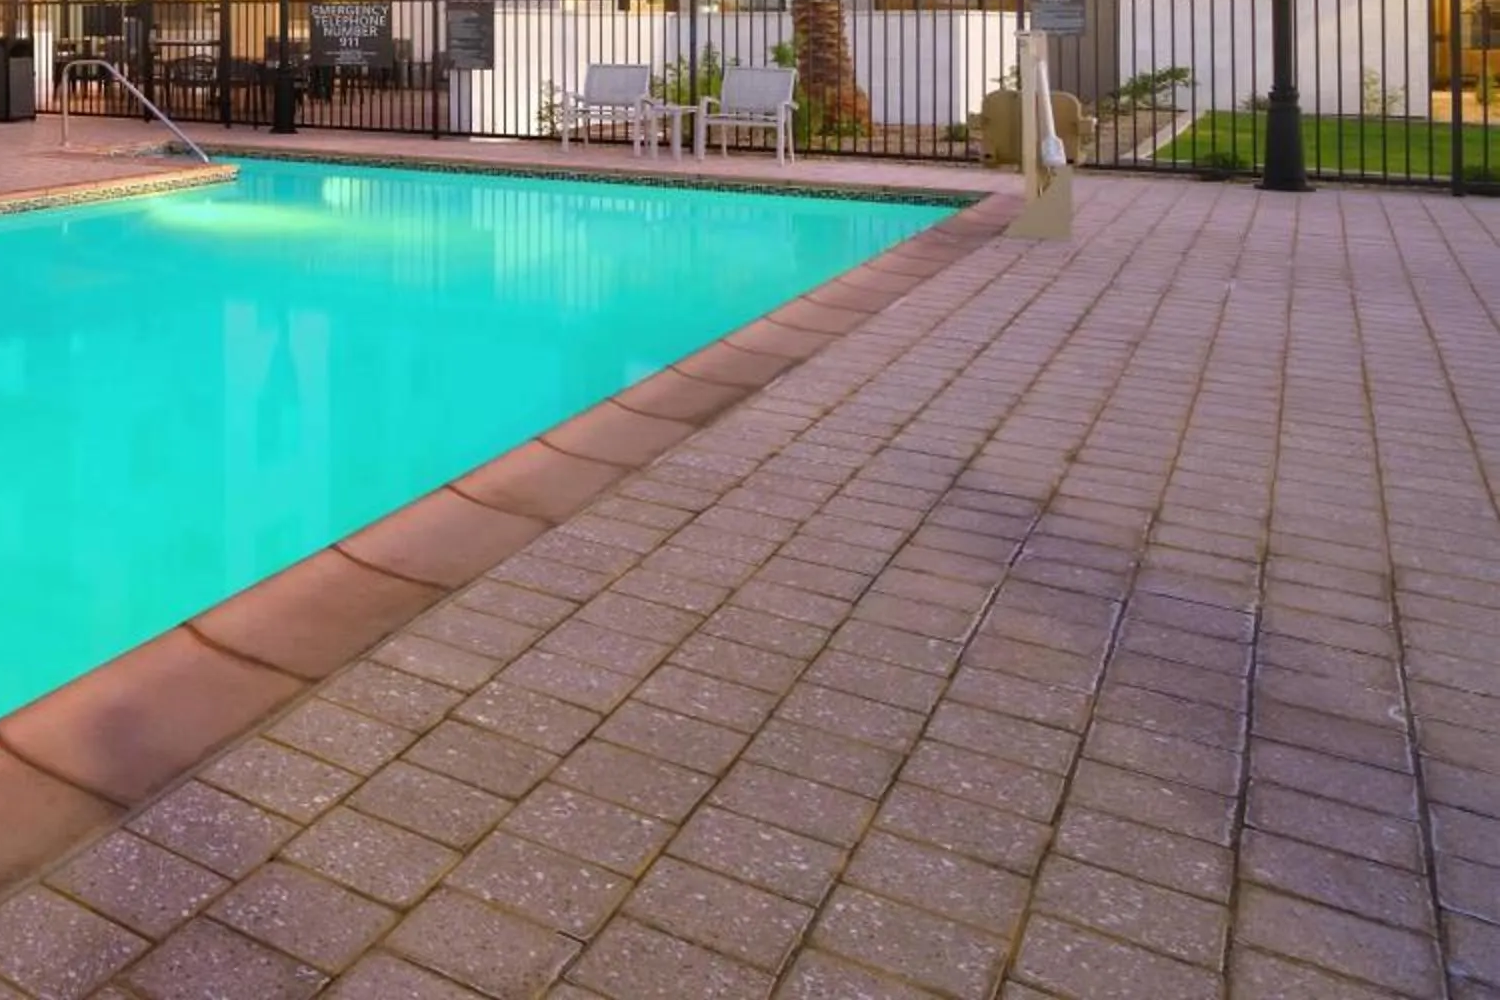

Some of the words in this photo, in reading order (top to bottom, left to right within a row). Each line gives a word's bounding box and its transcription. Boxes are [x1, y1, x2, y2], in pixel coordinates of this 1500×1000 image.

[311, 5, 389, 15] EMERGENCY
[314, 15, 387, 27] TELEPHONE
[323, 26, 379, 37] NUMBER
[339, 37, 360, 48] 911
